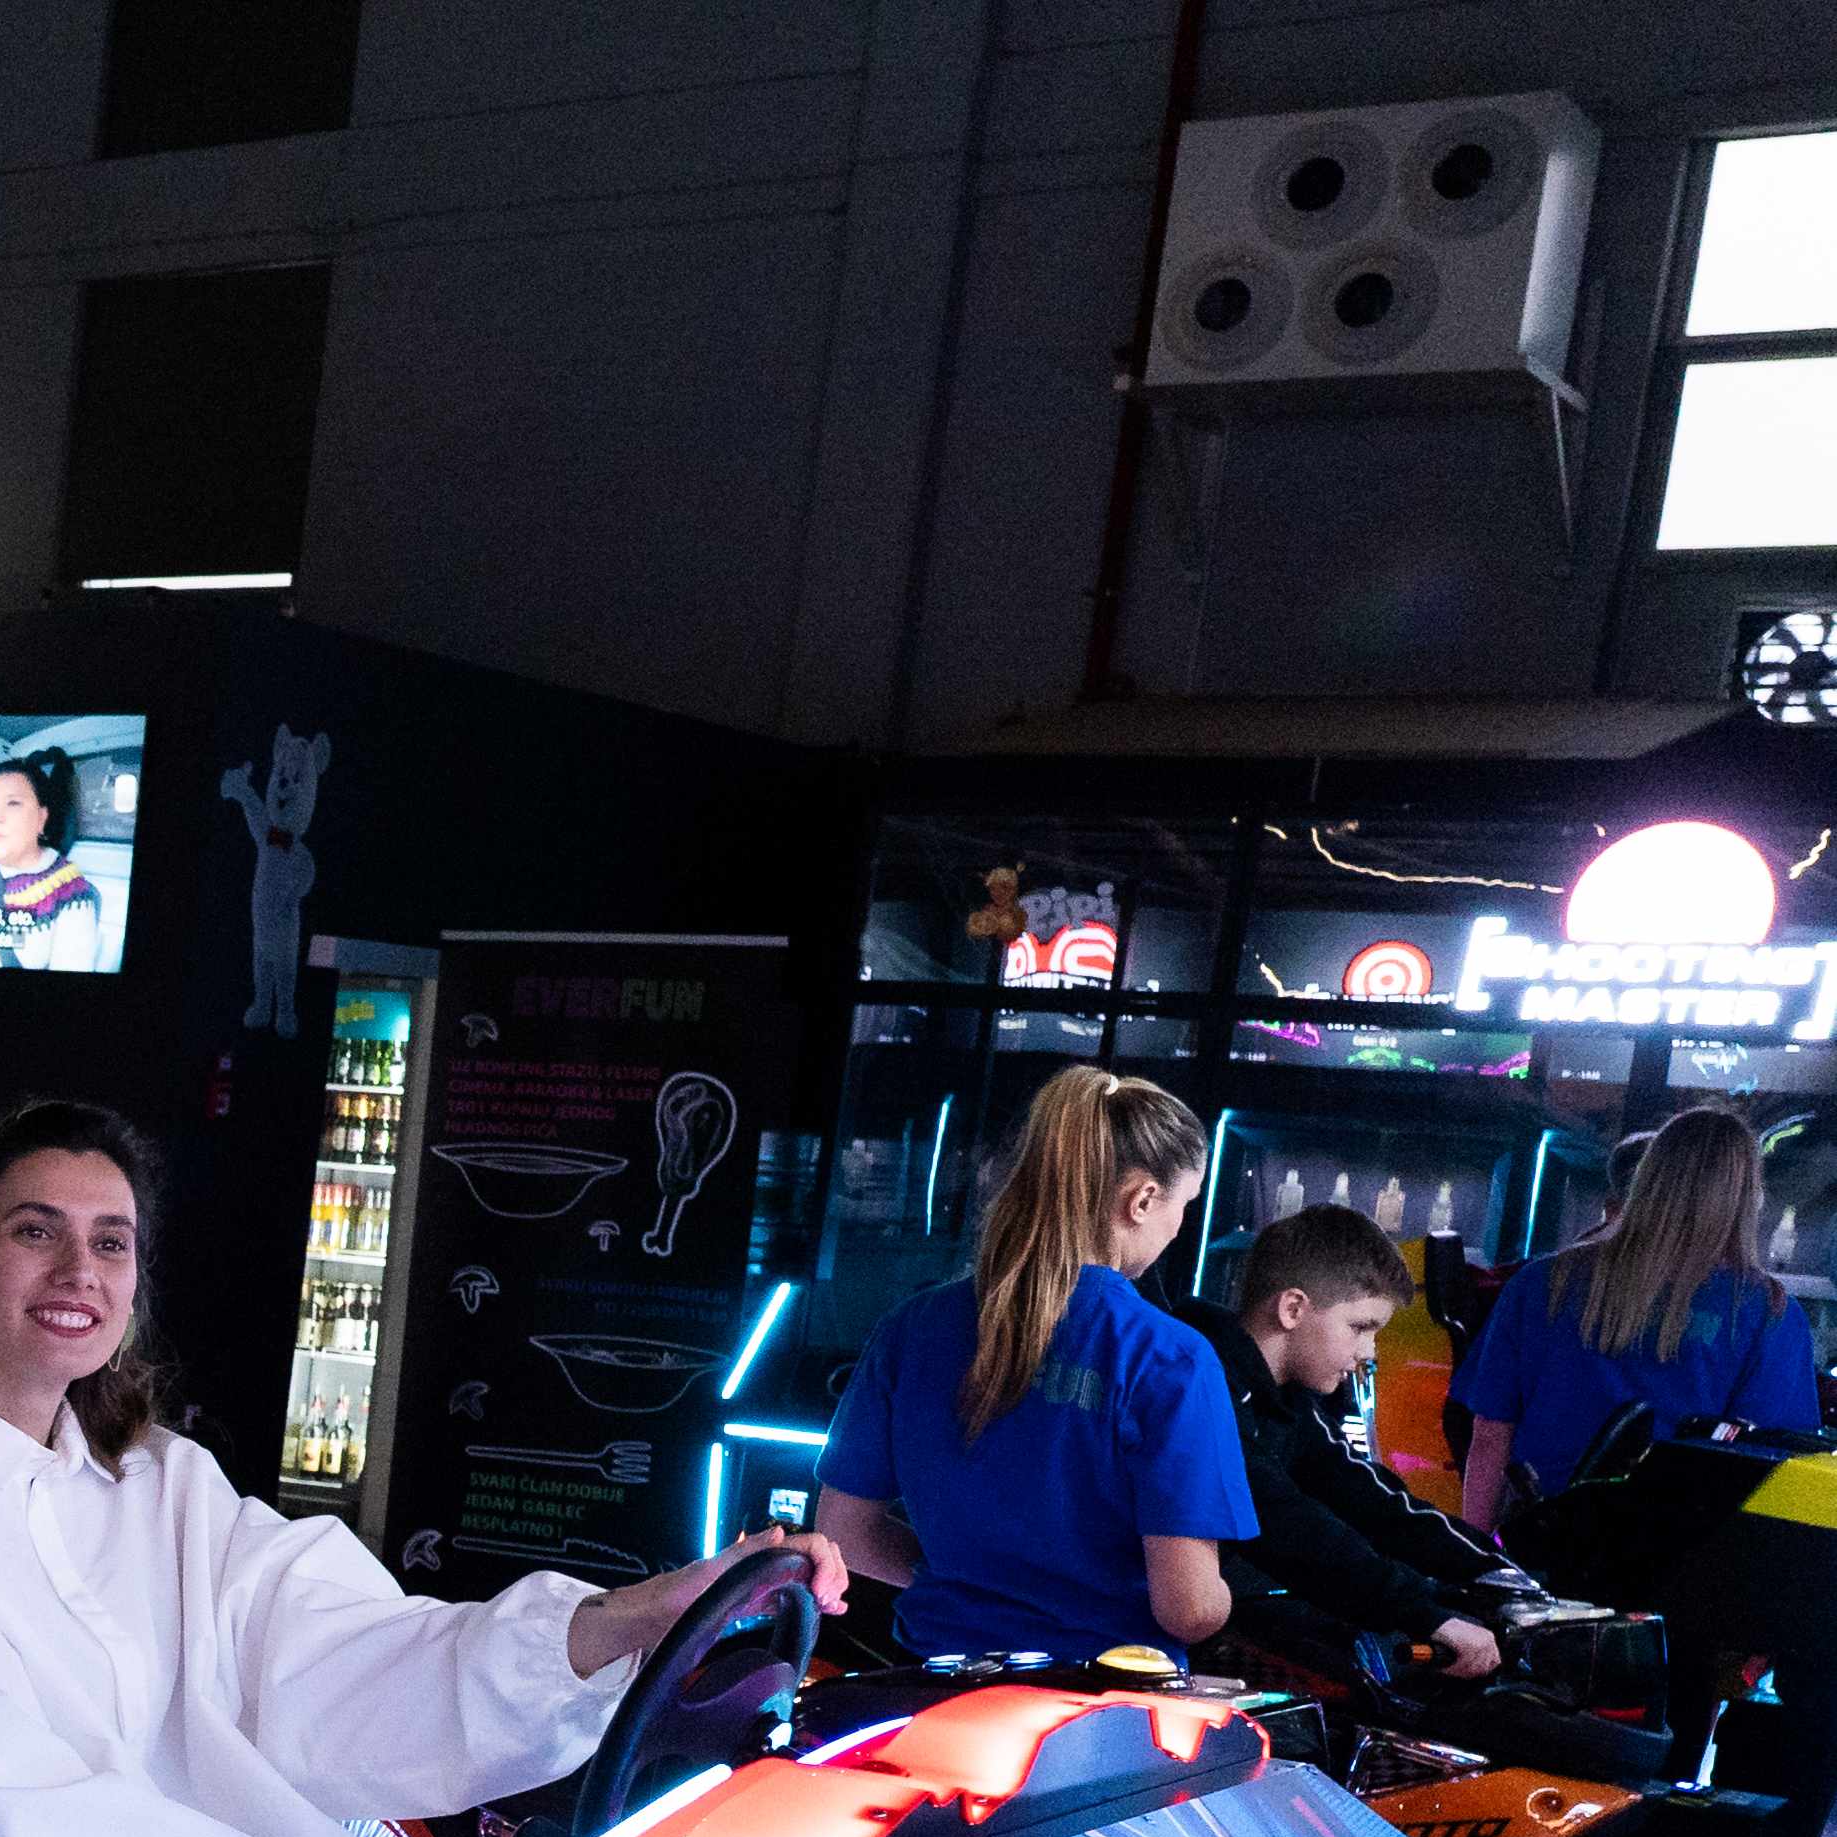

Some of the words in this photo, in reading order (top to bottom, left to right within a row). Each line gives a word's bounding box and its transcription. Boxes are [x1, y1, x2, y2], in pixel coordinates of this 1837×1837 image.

[1480, 935, 1818, 986] SHOOTING
[513, 977, 706, 1021] EVERFUN
[1520, 985, 1782, 1027] MASTER
[475, 1061, 545, 1077] BOWLING
[605, 1087, 653, 1101] LASER
[552, 1105, 615, 1121] JEDNOG
[445, 1120, 520, 1136] HLADNOG
[469, 1471, 516, 1489] SVAKI
[519, 1473, 564, 1494] ČLAN
[566, 1482, 627, 1504] DOBIJE
[464, 1492, 516, 1512] JEDAN
[521, 1499, 585, 1520] GABLEC
[460, 1513, 554, 1538] BESPLATNO
